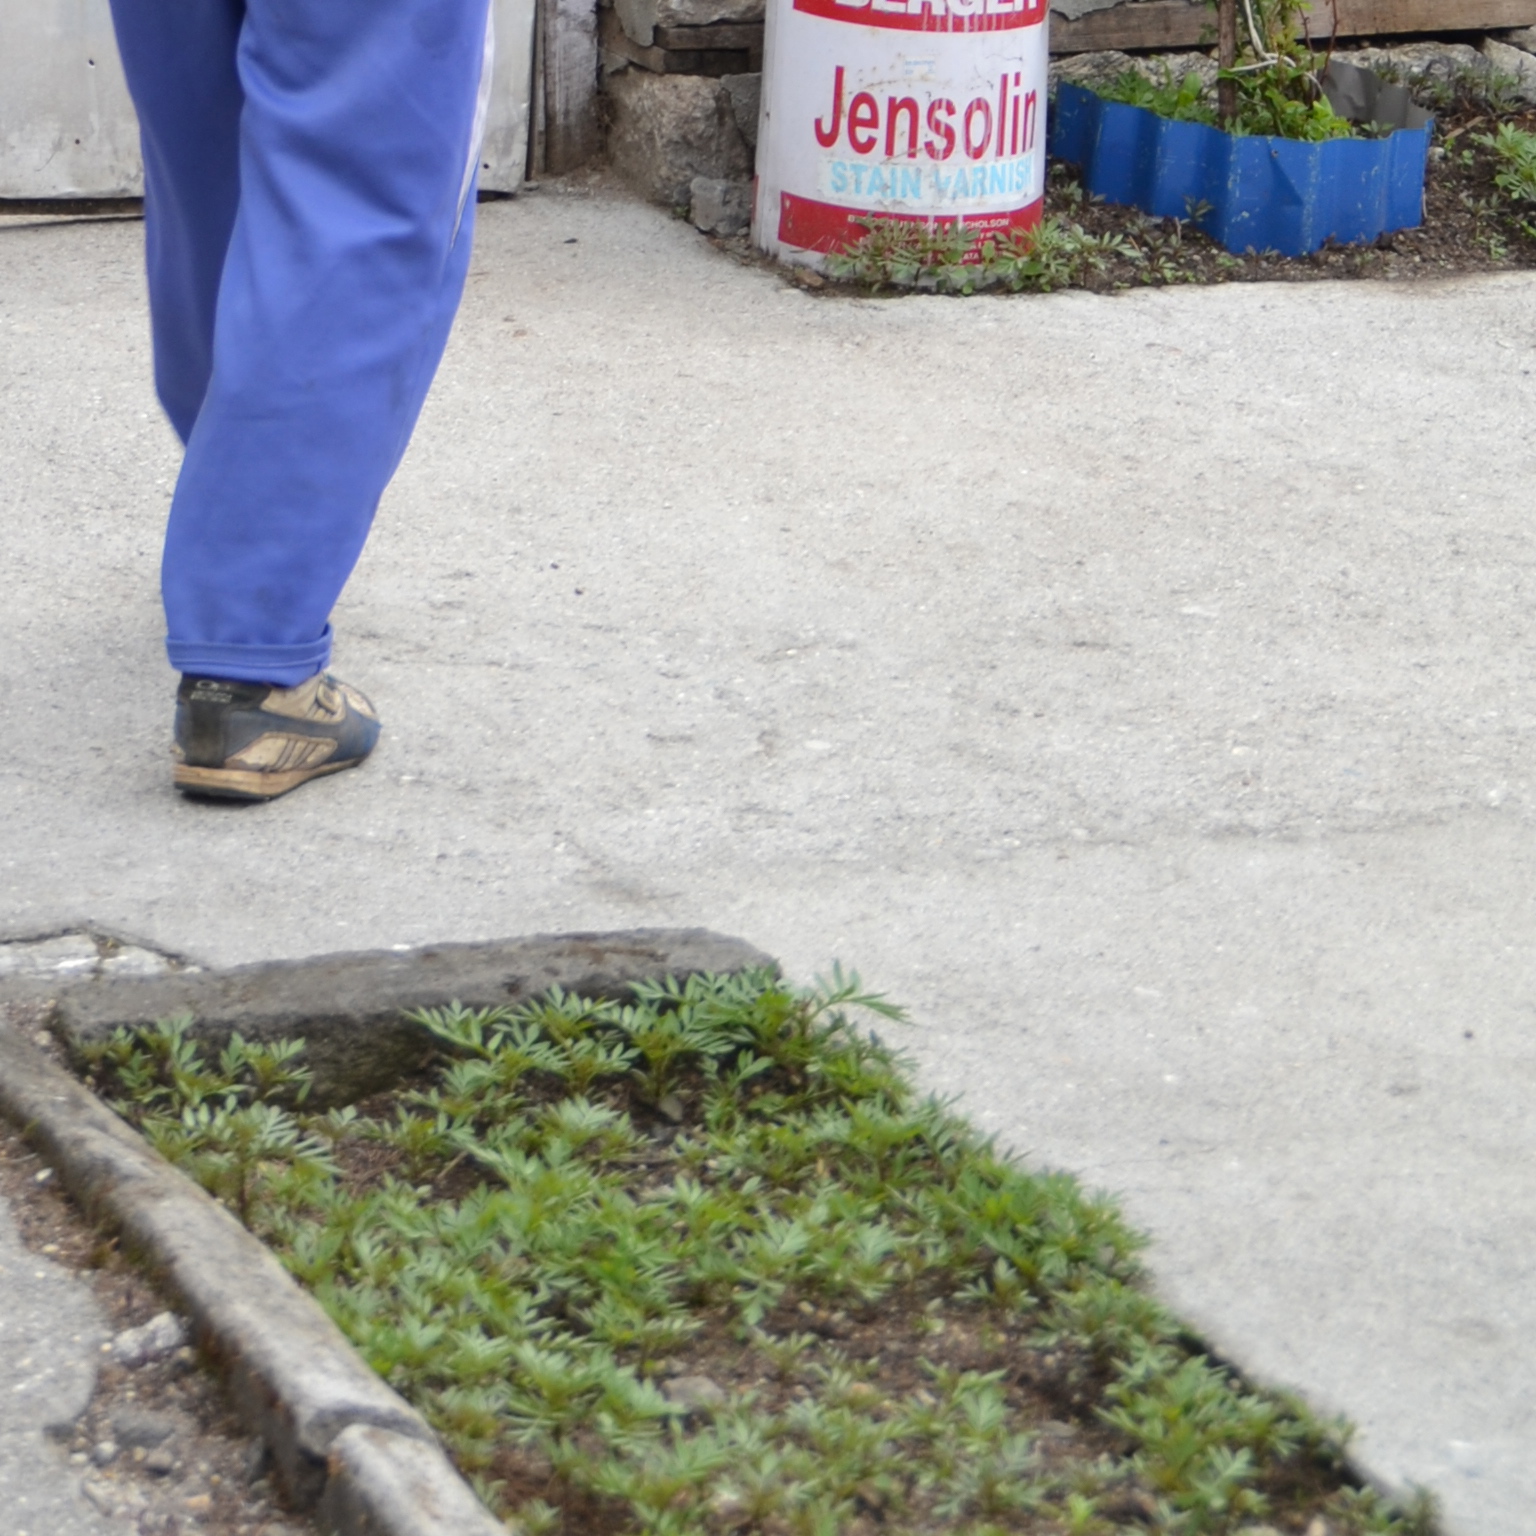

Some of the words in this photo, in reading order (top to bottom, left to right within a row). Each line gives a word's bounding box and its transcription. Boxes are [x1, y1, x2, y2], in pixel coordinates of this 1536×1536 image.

[814, 64, 1037, 162] Jensolin
[830, 161, 922, 200] STAIN
[934, 153, 1036, 198] VARNISH
